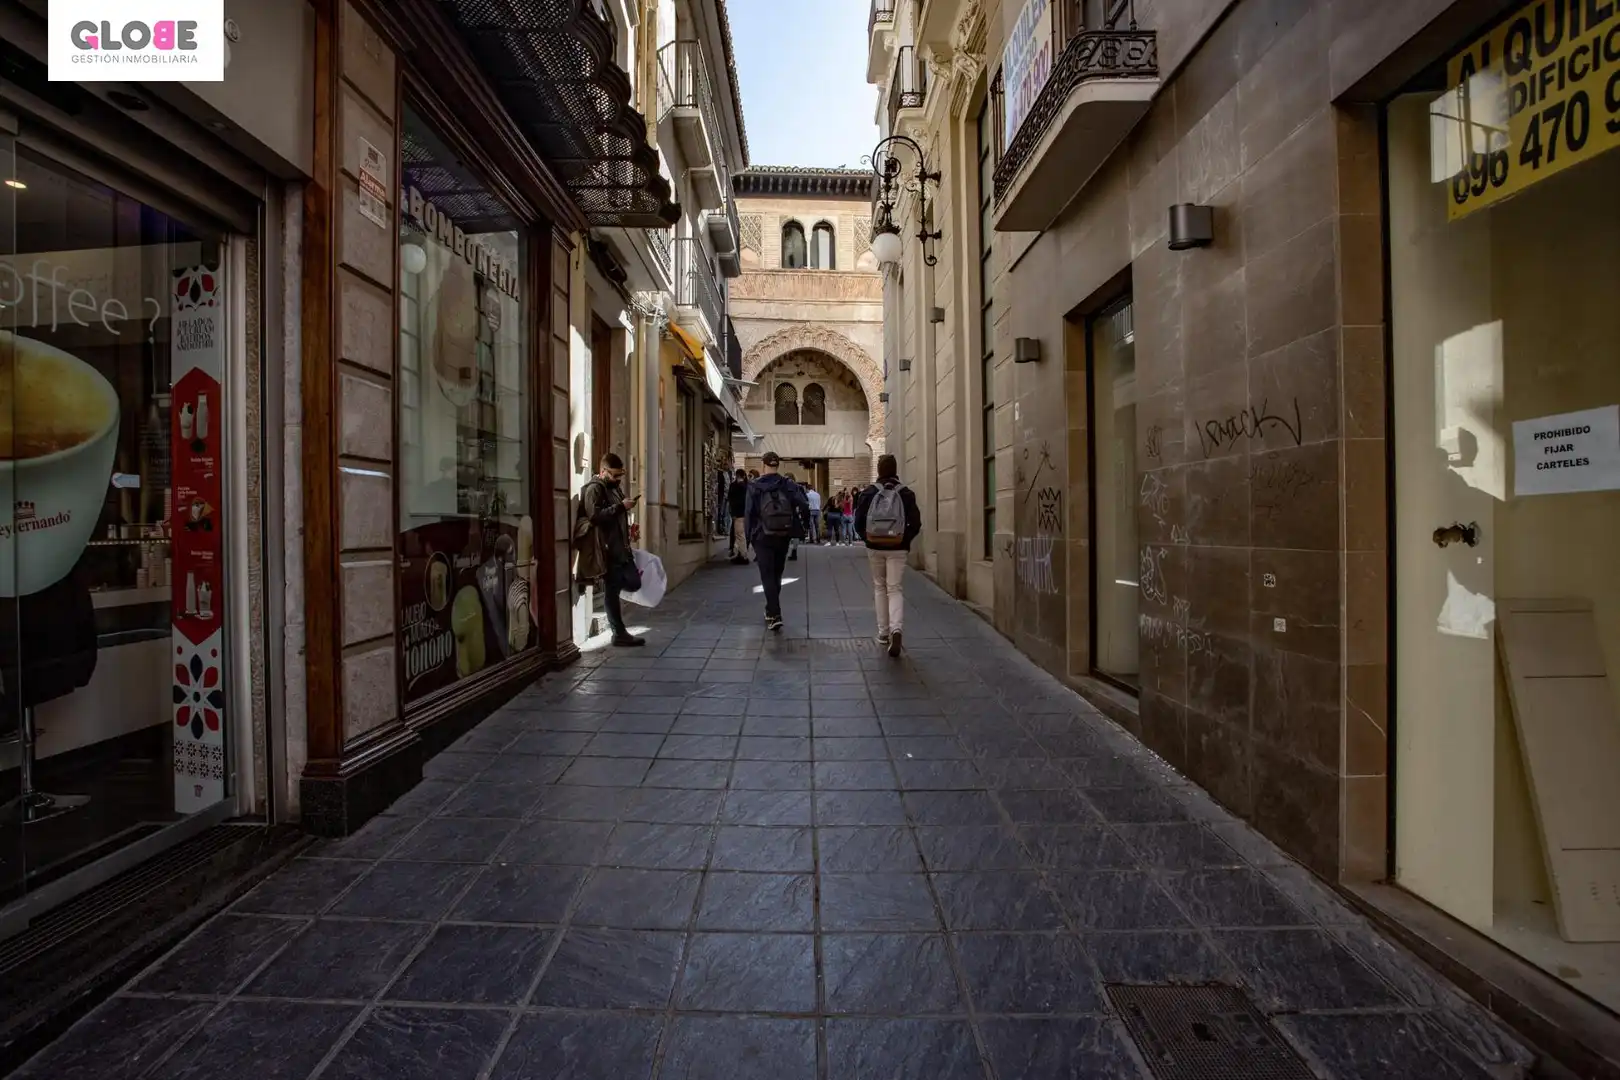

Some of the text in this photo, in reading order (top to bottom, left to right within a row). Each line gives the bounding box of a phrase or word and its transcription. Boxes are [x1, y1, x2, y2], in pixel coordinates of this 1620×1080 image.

[1459, 0, 1620, 90] ALQUIL
[1519, 90, 1590, 170] 470
[1533, 425, 1591, 440] PROHIBIDO
[1544, 443, 1573, 455] FIJAR
[1536, 457, 1589, 471] CARTELES
